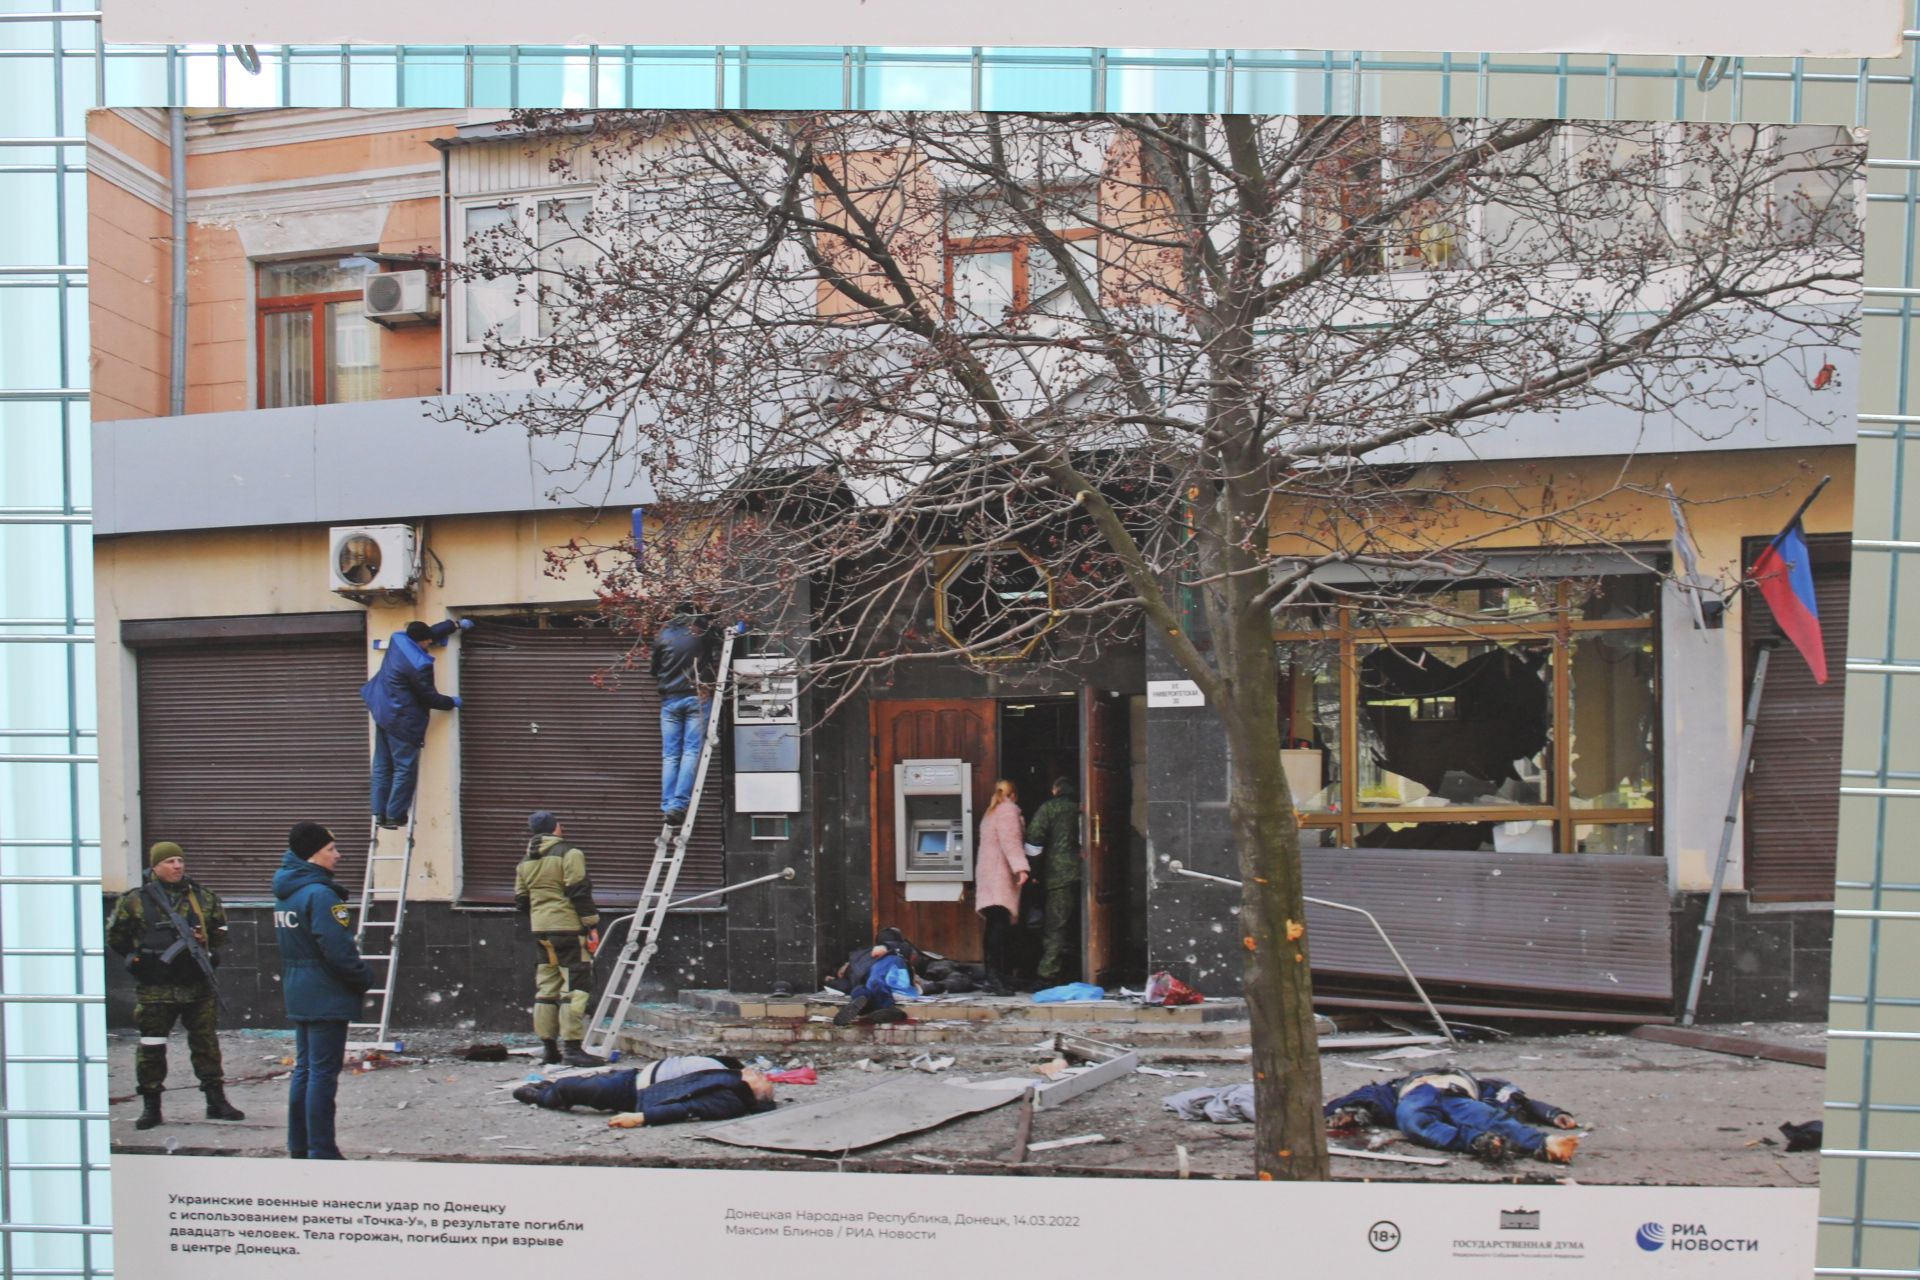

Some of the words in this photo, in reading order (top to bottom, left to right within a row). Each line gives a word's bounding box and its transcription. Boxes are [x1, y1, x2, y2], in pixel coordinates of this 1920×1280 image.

[168, 1193, 254, 1207] Украинские
[257, 1198, 319, 1208] военные
[322, 1200, 382, 1210] нанесли
[385, 1201, 420, 1213] удар
[423, 1202, 441, 1212] по
[443, 1201, 506, 1216] Донецку
[169, 1211, 177, 1220] с
[180, 1212, 298, 1223] использованием
[302, 1215, 353, 1226] ракеты
[356, 1215, 427, 1228] «Точка-У»,
[430, 1218, 439, 1228] в
[442, 1219, 520, 1231] результате
[524, 1219, 584, 1231] погибли
[724, 1208, 792, 1221] Донецкая
[796, 1210, 864, 1223] Народная
[867, 1211, 952, 1226] Республика,
[954, 1213, 1010, 1226] Донецк,
[1013, 1214, 1081, 1227] 14.03.2022
[725, 1224, 779, 1236] Максим
[782, 1225, 834, 1238] Блинов
[837, 1226, 843, 1237] /
[845, 1227, 875, 1238] РИА
[878, 1229, 936, 1240] Новости
[1373, 1230, 1397, 1242] 18+
[1671, 1223, 1708, 1236] РИА
[169, 1227, 236, 1238] двадцать
[238, 1229, 300, 1239] человек.
[302, 1229, 335, 1240] Тела
[338, 1232, 403, 1243] горожан,
[406, 1232, 478, 1244] погибших
[481, 1236, 509, 1247] при
[512, 1236, 564, 1248] взрыве
[1452, 1239, 1553, 1249] ГОСУДАРСТВЕННАЯ
[1554, 1241, 1585, 1250] ДУМА
[1671, 1238, 1759, 1252] НОВОСТИ
[170, 1243, 179, 1252] в
[182, 1243, 232, 1255] центре
[235, 1243, 300, 1256] Донецка.
